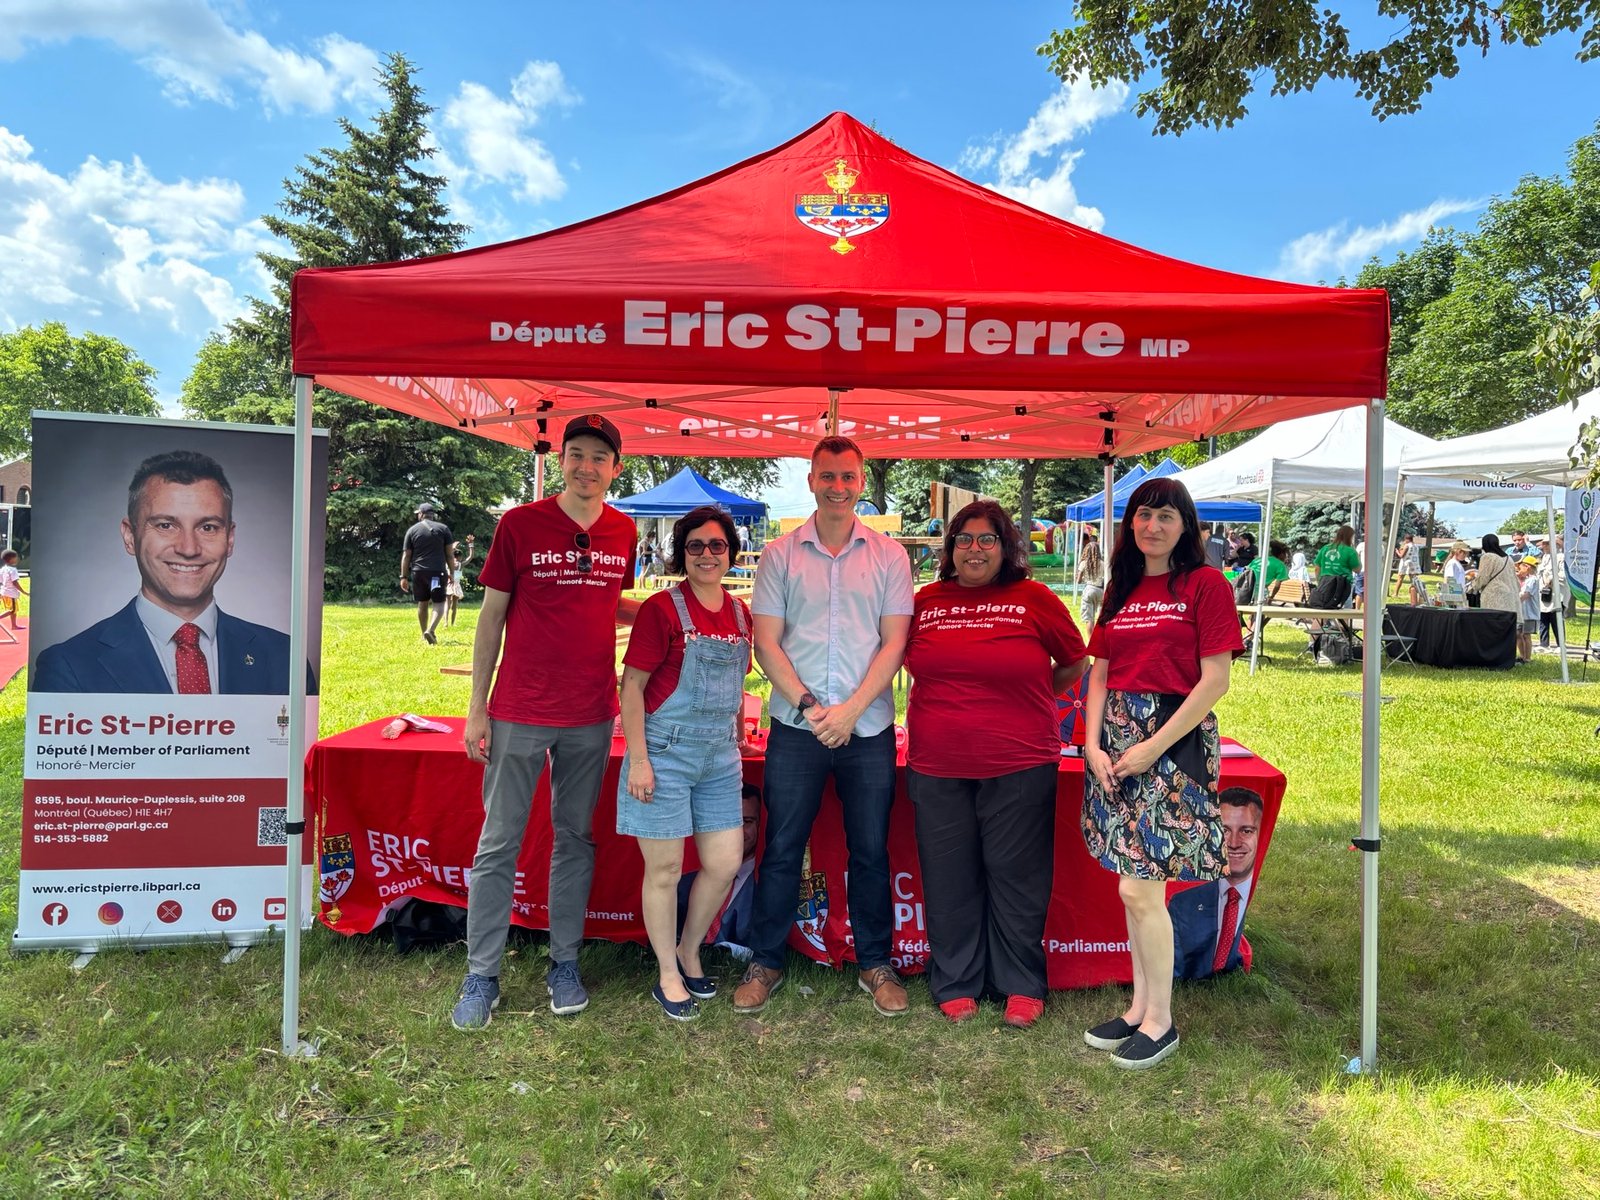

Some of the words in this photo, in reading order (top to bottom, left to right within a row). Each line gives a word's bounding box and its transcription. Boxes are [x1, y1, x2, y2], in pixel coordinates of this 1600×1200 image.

[490, 320, 606, 347] Député
[624, 300, 769, 349] Eric
[784, 304, 1125, 357] St-Pierre
[1140, 338, 1190, 358] MP
[532, 550, 562, 566] Eric
[565, 550, 626, 567] StPierre
[533, 569, 558, 578] Député
[919, 607, 947, 621] Eric
[950, 603, 1026, 614] St-Pierre
[1127, 601, 1187, 613] St-Pierre
[38, 713, 93, 735] Eric
[101, 713, 236, 735] St-Pierre
[36, 745, 87, 758] Député
[97, 745, 155, 755] Member
[158, 745, 171, 755] of
[174, 745, 250, 755] Parliament
[36, 760, 135, 770] Honoré-Mercier
[35, 796, 64, 805] 8595,
[66, 796, 93, 804] boul.
[95, 795, 197, 805] Maurice-Duplessis,
[199, 795, 225, 803] suite
[226, 794, 246, 803] 208
[34, 809, 80, 817] Montréal
[83, 807, 133, 818] (Québec)
[153, 808, 173, 816] 4H7
[33, 821, 169, 832] eric.st-pierre@parl.gc.ca
[33, 834, 109, 843] 514-353-5882
[367, 829, 430, 861] ERIC
[32, 882, 201, 895] www.ericstpierre.libparl.ca
[378, 875, 427, 898] Déput
[585, 909, 634, 920] iament
[1049, 939, 1132, 953] Parliament
